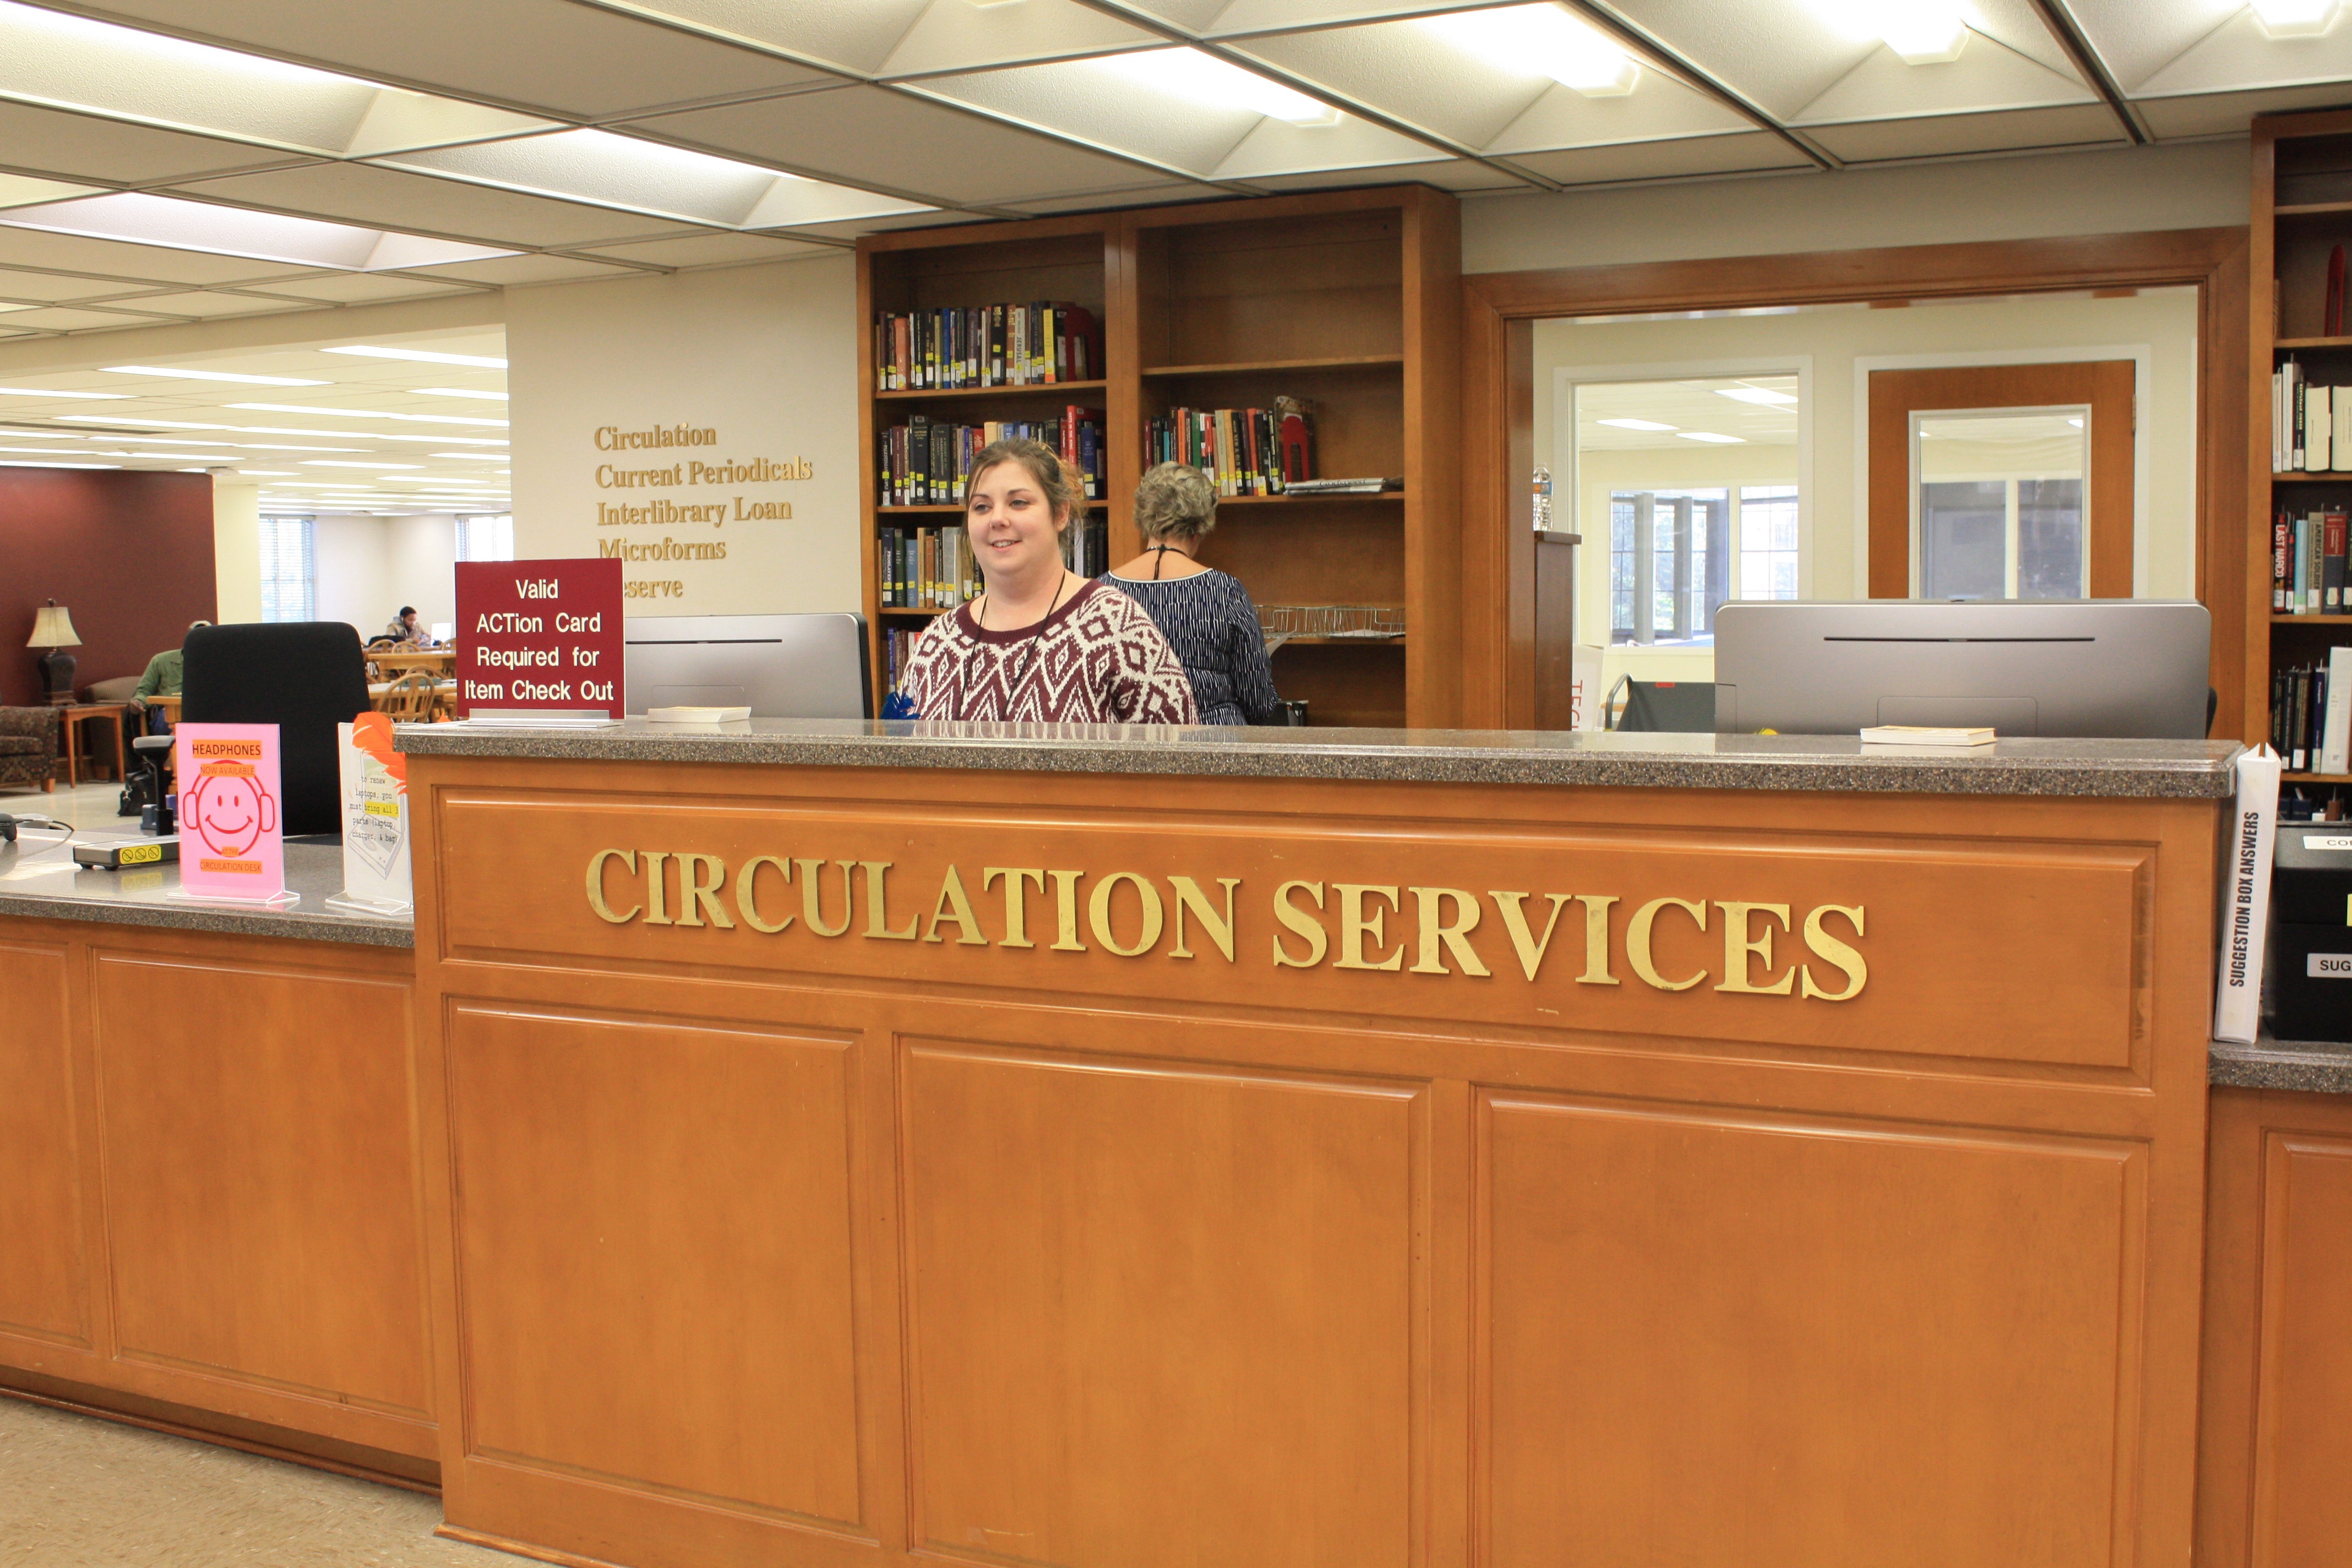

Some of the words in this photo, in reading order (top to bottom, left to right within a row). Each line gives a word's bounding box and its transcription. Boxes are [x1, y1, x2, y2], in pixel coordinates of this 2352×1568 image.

[594, 423, 716, 450] Circulation
[595, 463, 683, 488] Current
[687, 456, 813, 485] Periodicals
[597, 500, 727, 528] Interlibrary
[733, 497, 792, 521] Loan
[598, 537, 727, 562] Microforms
[515, 579, 558, 599] Valid
[624, 580, 683, 598] serve
[476, 613, 542, 633] ACTion
[555, 612, 601, 633] Card
[477, 646, 559, 670] Required
[572, 646, 600, 666] for
[465, 679, 503, 699] Item
[511, 679, 571, 700] Check
[580, 680, 614, 700] Out
[192, 744, 261, 755] HEADPHONES
[220, 767, 254, 775] AVAILABLE
[364, 804, 380, 814] bring
[2239, 812, 2259, 875] ANSWERS
[200, 862, 243, 870] CIRCULATION
[2237, 876, 2252, 904] BOX
[586, 848, 1242, 963] CIRCULATION
[1273, 880, 1868, 1001] SERVICES
[2230, 907, 2250, 987] SUGGESTION
